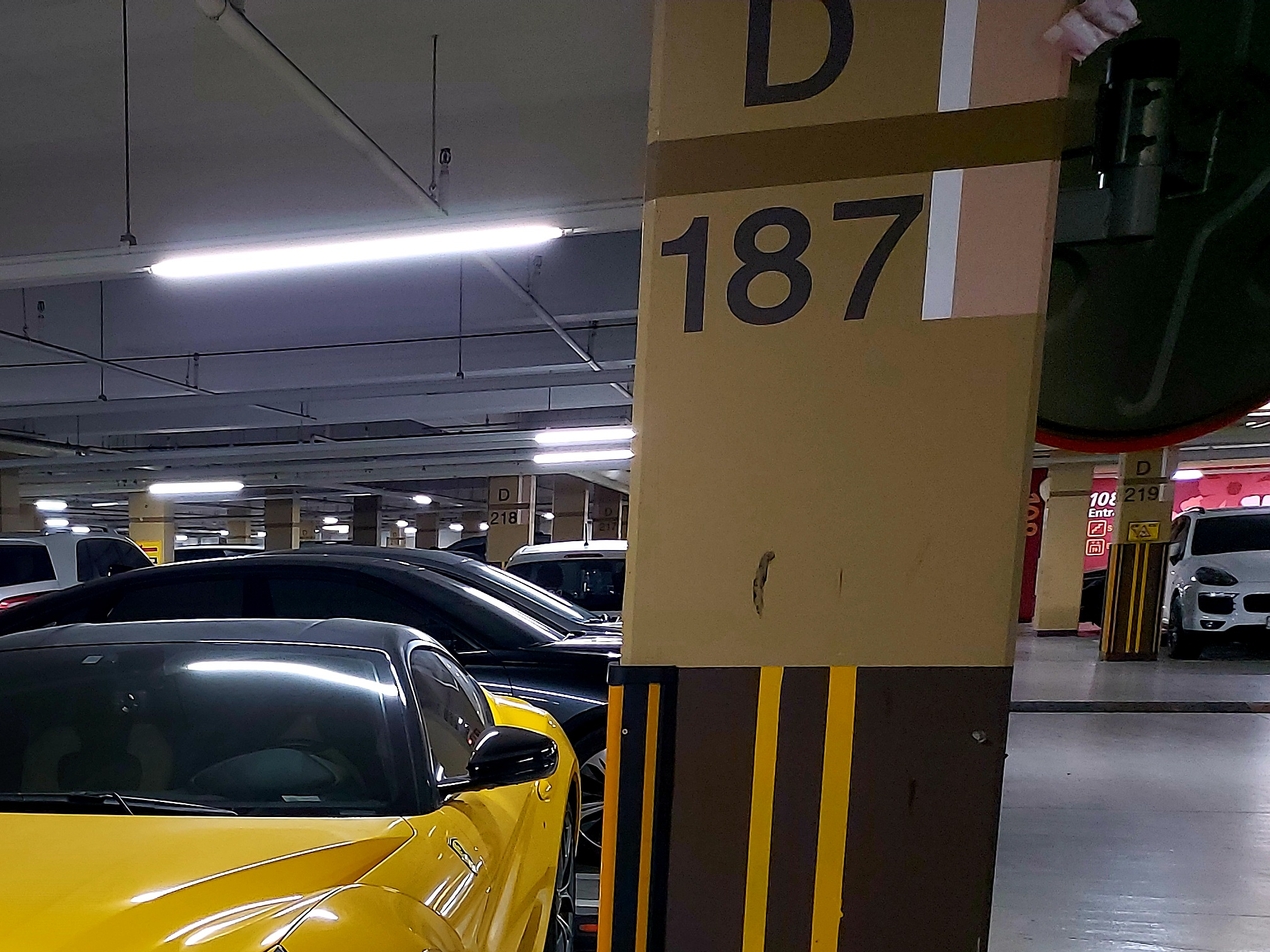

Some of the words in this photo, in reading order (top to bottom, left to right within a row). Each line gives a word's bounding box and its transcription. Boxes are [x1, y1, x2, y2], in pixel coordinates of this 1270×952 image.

[744, 0, 855, 107] D
[660, 195, 924, 333] 187
[1136, 461, 1151, 475] D
[498, 488, 510, 501] D
[1125, 486, 1160, 502] 219
[490, 511, 518, 525] 218
